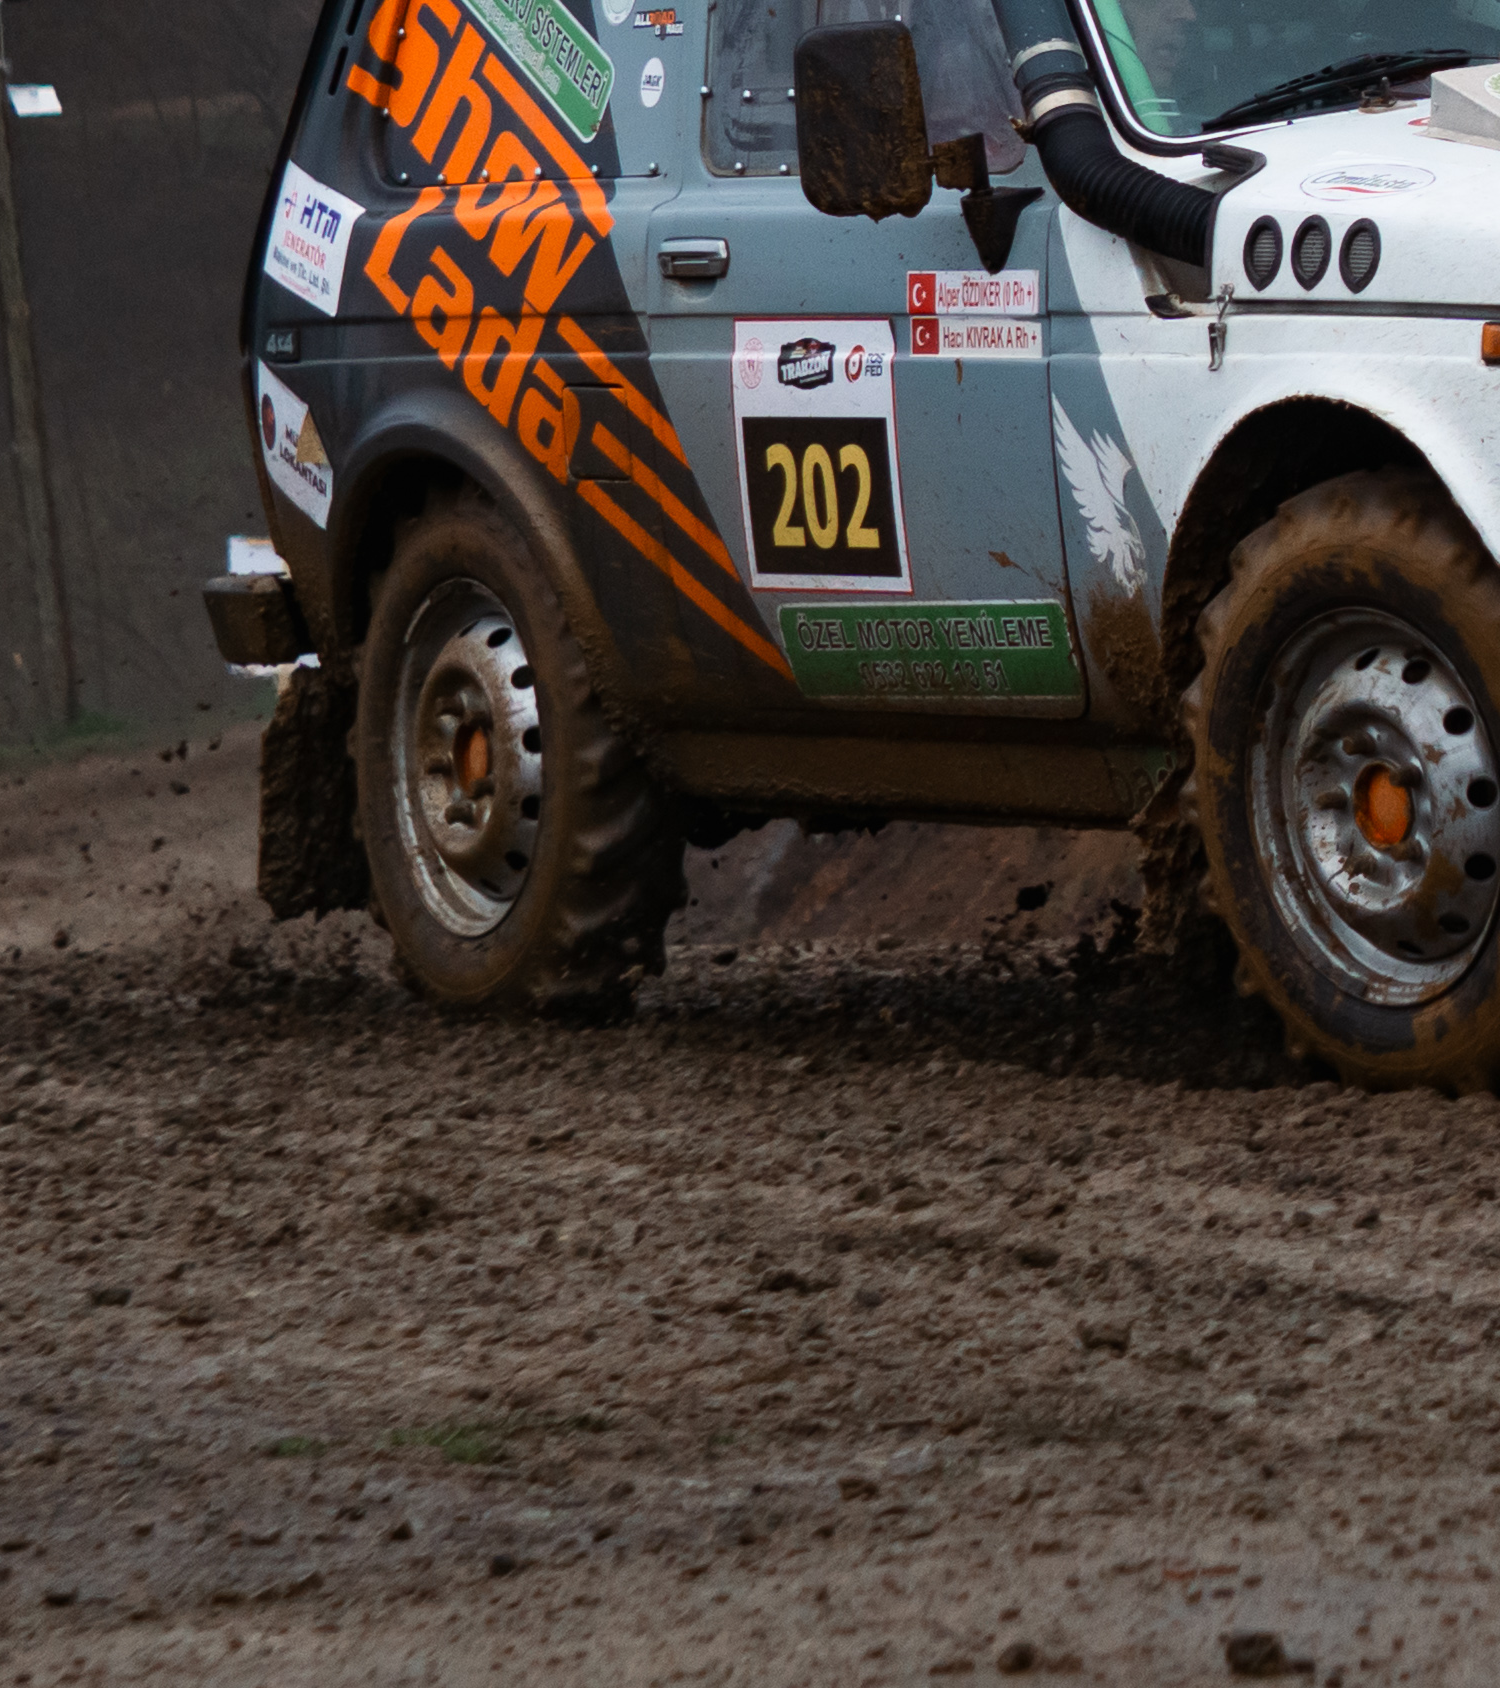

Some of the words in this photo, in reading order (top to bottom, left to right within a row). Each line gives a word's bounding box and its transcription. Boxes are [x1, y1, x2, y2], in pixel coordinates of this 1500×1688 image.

[531, 4, 610, 109] SİSTEMLERİ
[300, 194, 342, 244] HTM
[1013, 281, 1025, 306] Rh
[363, 186, 581, 485] Lada
[943, 327, 964, 348] Hacı
[967, 327, 1004, 348] KIVRAK
[1006, 327, 1013, 348] A
[1015, 327, 1029, 348] Rh
[780, 350, 832, 382] TRABZON
[865, 365, 883, 377] FED
[766, 443, 880, 549] 202
[798, 613, 855, 650] ÖZEL
[856, 618, 938, 650] MOTOR
[938, 611, 1053, 650] YENİLEME
[983, 659, 1010, 691] 51
